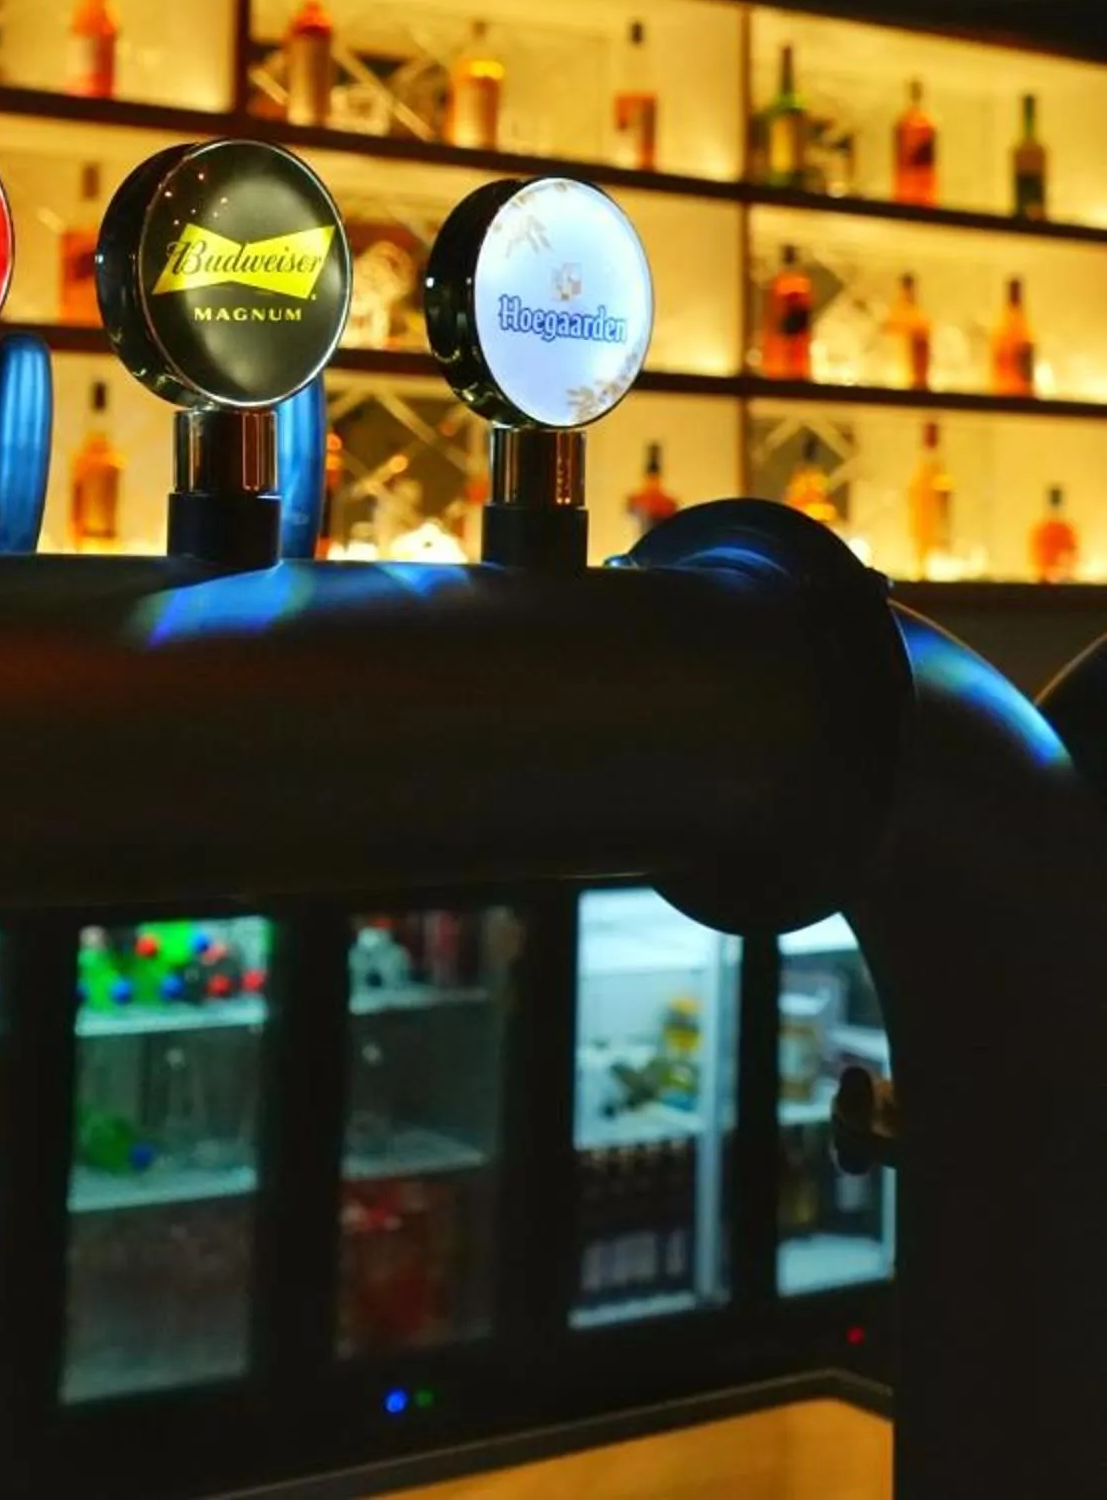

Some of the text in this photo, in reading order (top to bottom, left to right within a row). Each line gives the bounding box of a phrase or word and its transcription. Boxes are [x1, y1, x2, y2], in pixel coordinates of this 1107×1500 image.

[167, 240, 322, 276] Budweiser
[194, 307, 302, 322] MAGNUM
[499, 294, 627, 342] Hoegaarden
